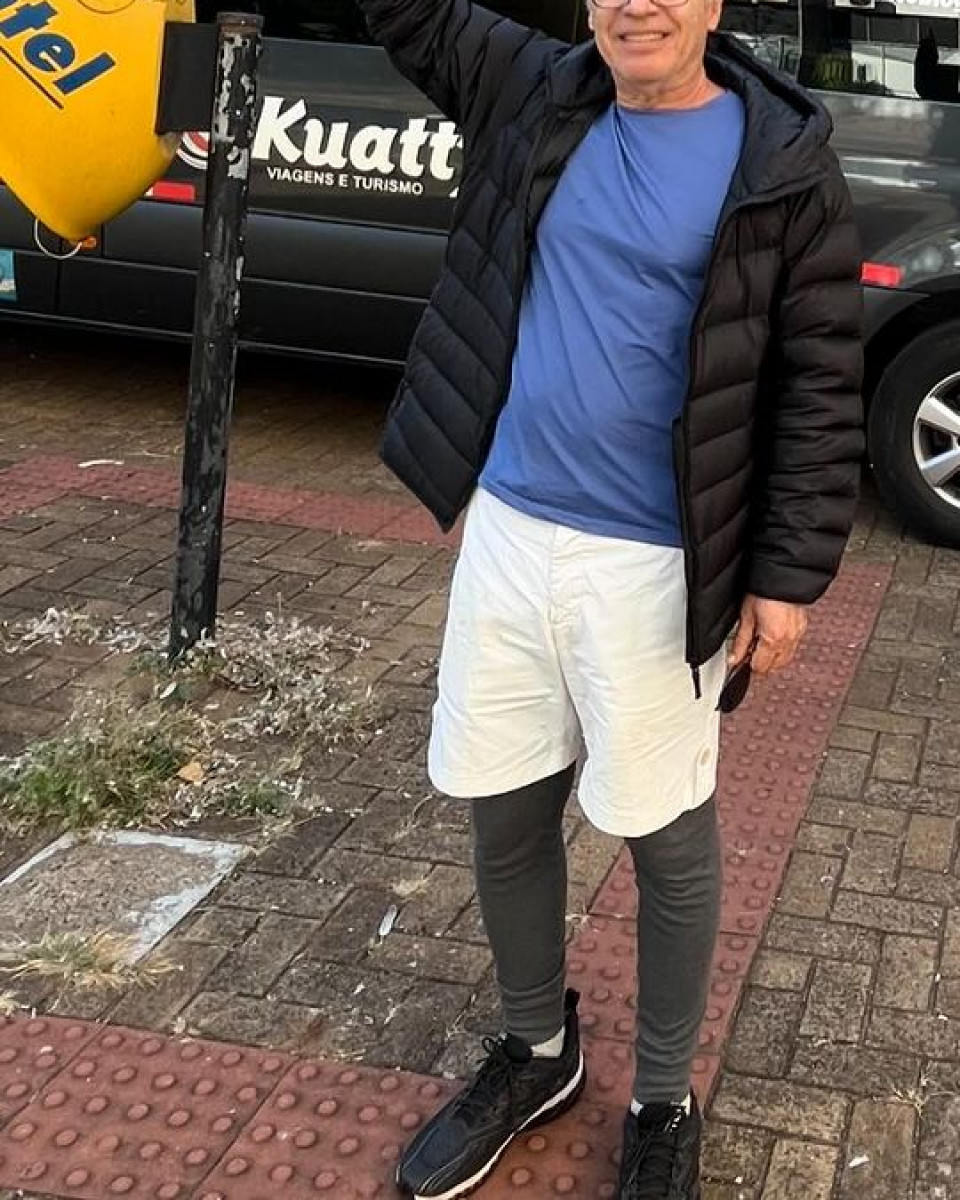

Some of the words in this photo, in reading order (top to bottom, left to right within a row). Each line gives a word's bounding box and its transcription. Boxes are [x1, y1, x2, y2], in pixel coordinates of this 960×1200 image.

[266, 166, 334, 188] VIAGENS
[339, 173, 349, 188] E
[353, 174, 425, 196] TURISMO
